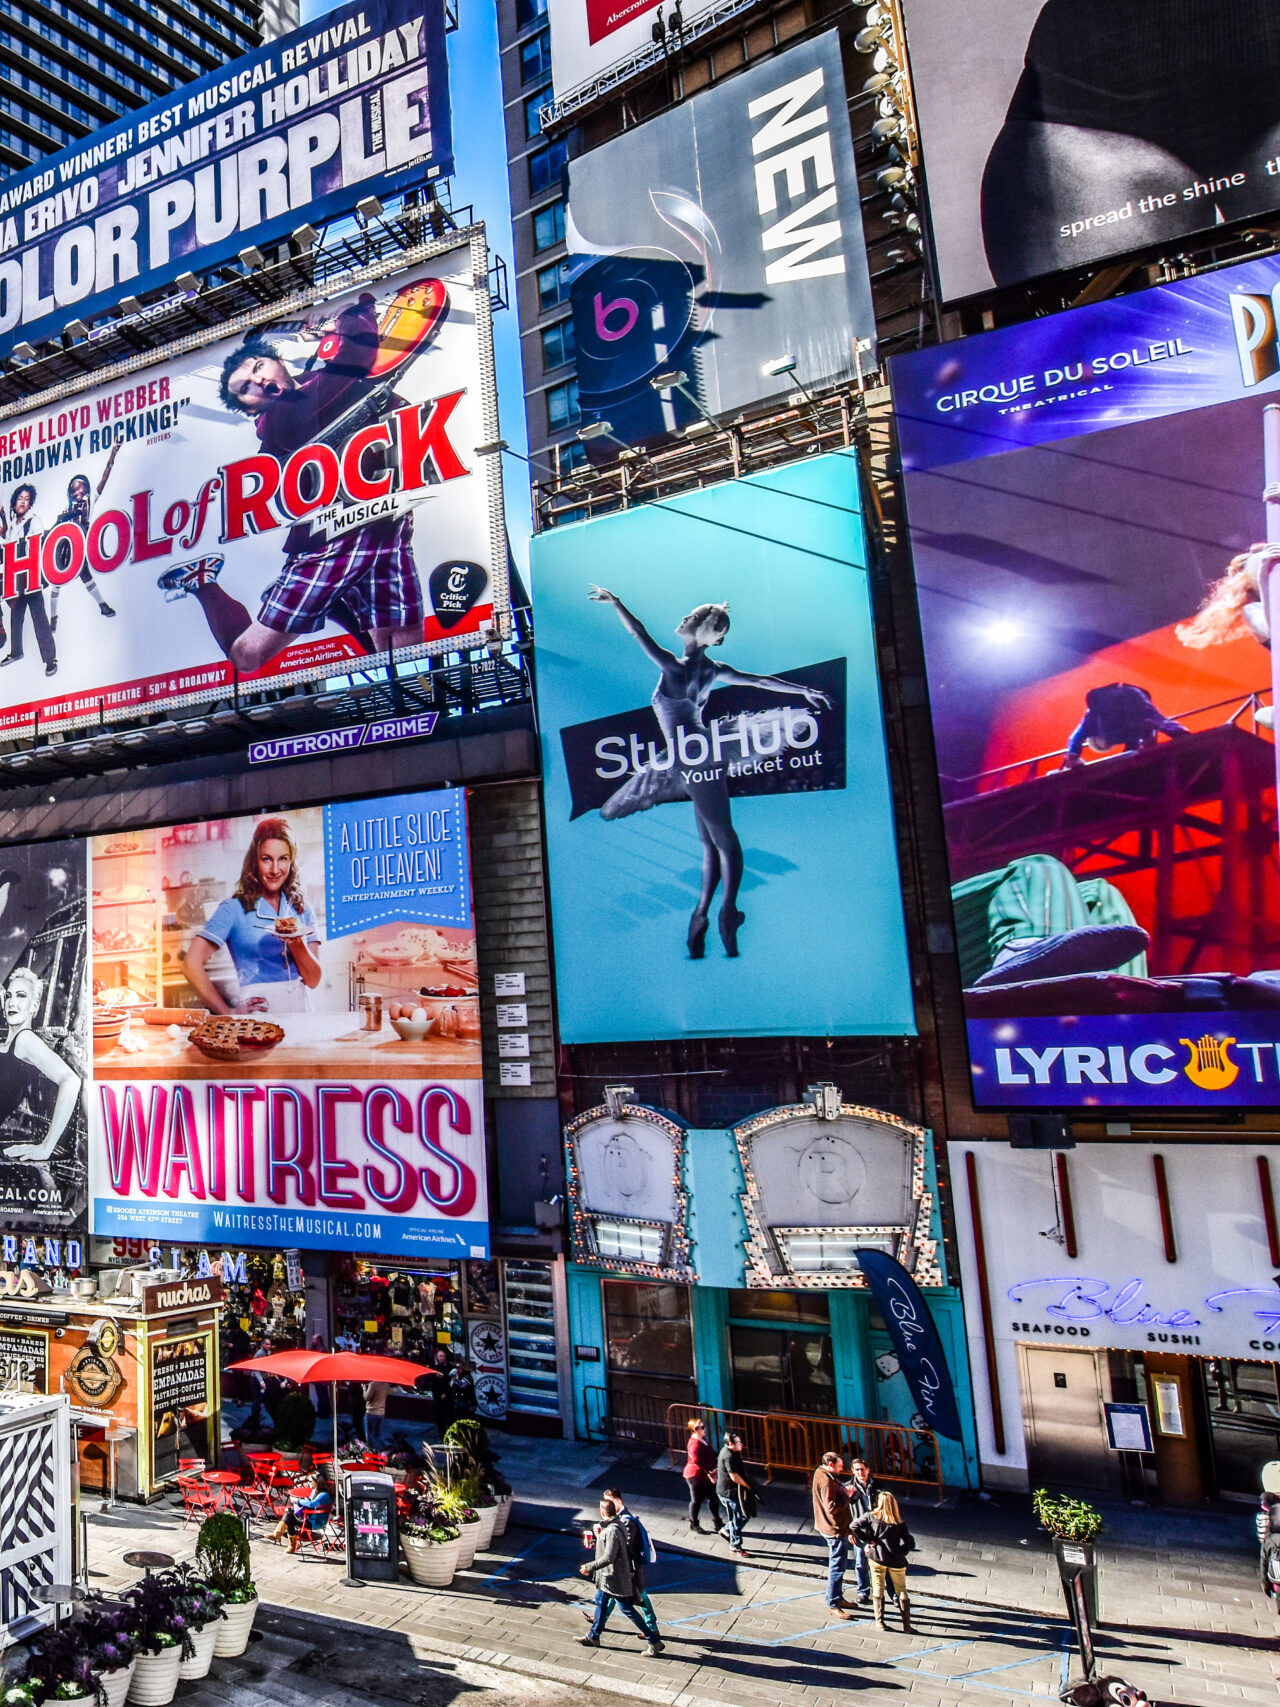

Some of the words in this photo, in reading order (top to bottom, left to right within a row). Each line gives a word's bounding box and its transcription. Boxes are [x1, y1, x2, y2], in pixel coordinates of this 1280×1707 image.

[0, 169, 55, 215] AWARD
[59, 128, 133, 182] WINNER!
[138, 103, 183, 143] BEST
[188, 62, 277, 118] MUSICAL
[281, 12, 370, 73] REVIVAL
[370, 89, 382, 132] MUSICAL
[24, 176, 99, 242] ERIVO
[118, 100, 255, 196] JENNIFER
[262, 15, 424, 128] HOLLIDAY
[149, 66, 433, 270] PURPLE
[748, 67, 846, 286] NEW
[1060, 203, 1133, 238] spread
[1138, 191, 1177, 214] the
[1182, 171, 1246, 200] shine
[936, 374, 1036, 412] CIRQUE
[1044, 362, 1083, 387] DU
[1091, 337, 1193, 375] SOLEIL
[38, 404, 91, 444] LLOYD
[96, 376, 171, 422] WEBBER
[998, 384, 1114, 416] THEATRICAL
[146, 432, 171, 446] REUTERS
[164, 479, 220, 549] of
[218, 387, 473, 545] ROCK
[317, 506, 338, 525] THE
[332, 498, 400, 533] MUSICAL
[442, 600, 462, 609] Pick
[280, 655, 314, 669] American
[314, 649, 344, 664] Airlines
[286, 647, 312, 658] OFFICIAL
[313, 642, 336, 652] AIRLINE
[43, 701, 73, 718] WINTER
[74, 694, 105, 713] GARDEN
[107, 686, 141, 705] THEATRE
[149, 681, 168, 696] 50TH
[169, 679, 178, 692] &
[179, 669, 227, 690] BROADWAY
[253, 728, 359, 760] OUTFRONT
[372, 716, 431, 739] PRIME
[595, 706, 819, 779] StubHub
[681, 767, 722, 785] Your
[728, 756, 783, 778] ticket
[789, 750, 823, 769] out
[355, 815, 402, 852] LITTLE
[407, 809, 451, 846] SLICE
[352, 856, 370, 889] OF
[342, 889, 416, 902] ENTERTAINMENT
[418, 885, 455, 895] WEEKLY
[995, 1044, 1178, 1084] LYRIC
[99, 1084, 477, 1216] WAITRESS
[32, 1208, 51, 1216] American
[130, 1215, 149, 1223] WEST
[138, 1208, 168, 1217] ATKINSON
[169, 1210, 199, 1218] THEATRE
[401, 1232, 431, 1243] American
[431, 1234, 457, 1244] Airlines
[157, 1283, 212, 1309] nuchas
[1008, 1279, 1201, 1328] Blue
[0, 1313, 23, 1321] COFFEE
[887, 1277, 924, 1353] Blue
[918, 1357, 940, 1417] Fin
[1012, 1322, 1091, 1337] SEAFOOD
[1147, 1332, 1201, 1346] SUSHI
[1249, 1340, 1280, 1351] CO
[153, 1364, 174, 1377] FRESH
[179, 1358, 205, 1370] BAKED
[153, 1368, 205, 1390] EMPANADAS
